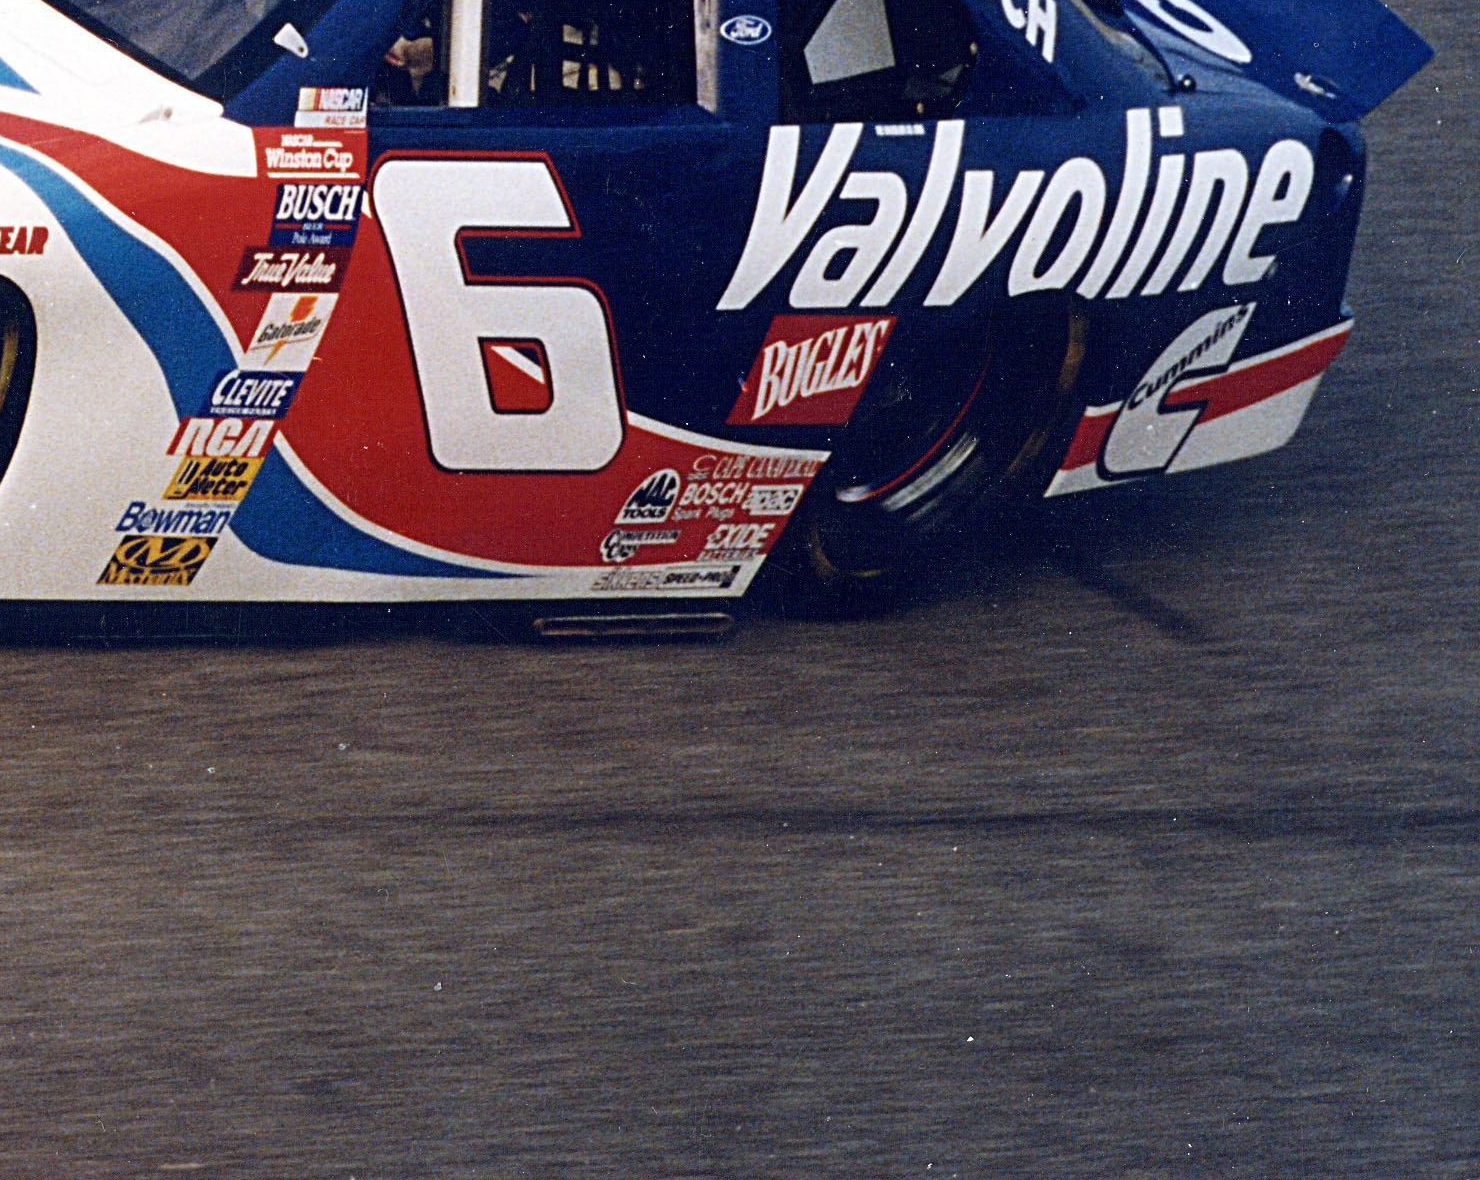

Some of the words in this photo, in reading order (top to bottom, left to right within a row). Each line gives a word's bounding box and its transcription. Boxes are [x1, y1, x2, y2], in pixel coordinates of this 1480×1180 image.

[730, 19, 763, 39] Ford
[265, 147, 322, 169] Winston
[324, 147, 353, 173] Cup
[276, 184, 361, 220] BUSCH
[716, 105, 1315, 312] Valvoline
[257, 316, 322, 343] Gatorade
[372, 158, 624, 472] 6
[751, 319, 890, 421] BUGLES
[1127, 304, 1249, 411] Cummins
[211, 369, 294, 407] CLEVITE
[176, 417, 275, 457] RCA
[200, 458, 249, 477] Auto
[680, 481, 751, 506] BOSCH
[115, 501, 231, 534] Bowman
[623, 507, 667, 519] TOOLS
[704, 523, 776, 549] EXIDE
